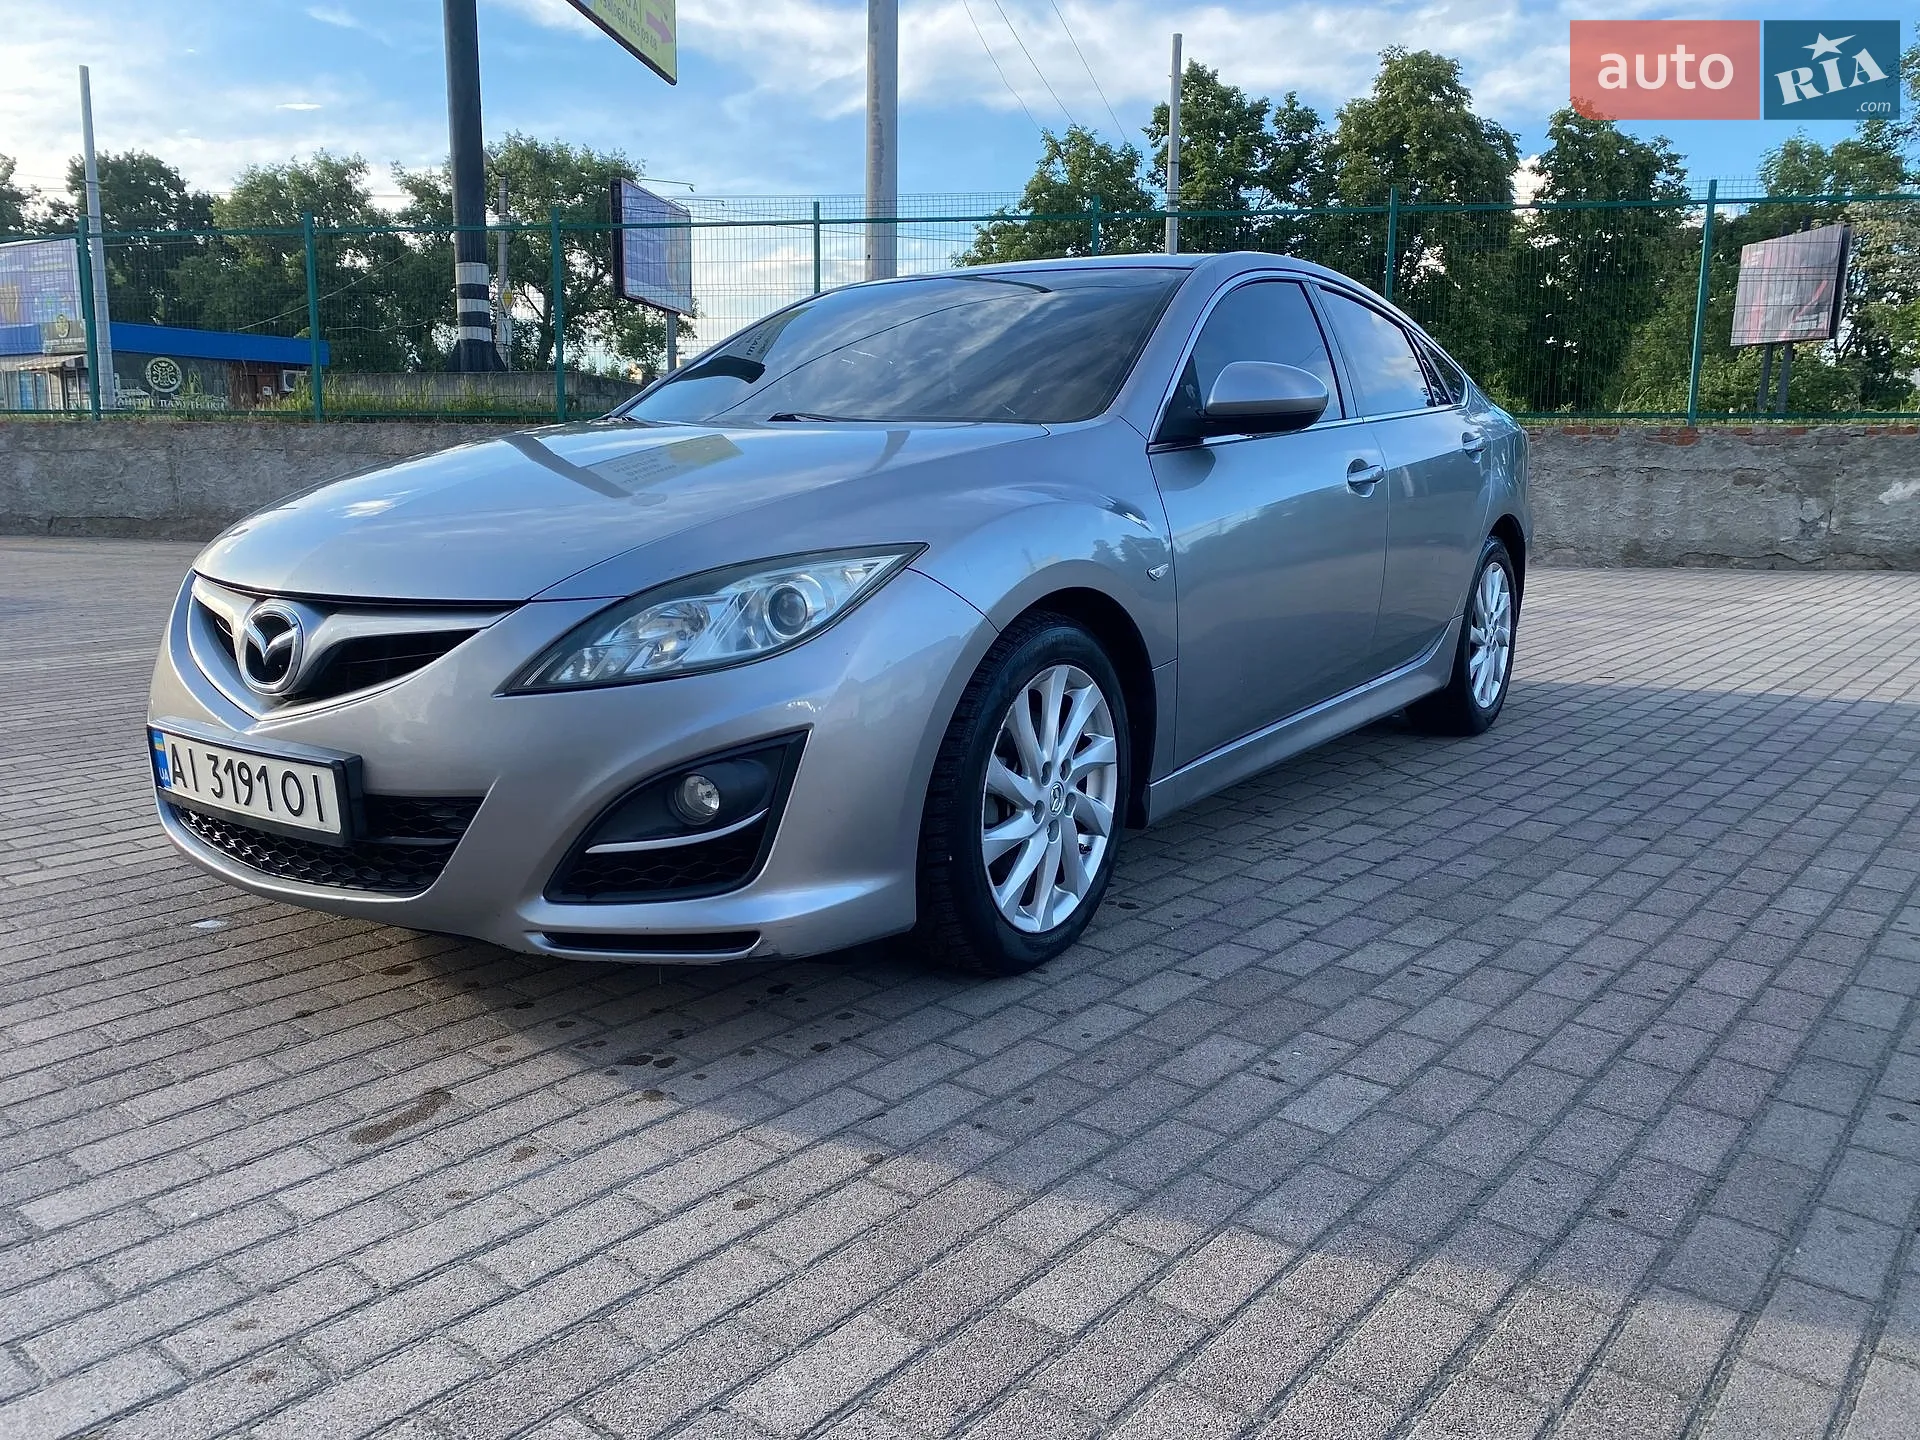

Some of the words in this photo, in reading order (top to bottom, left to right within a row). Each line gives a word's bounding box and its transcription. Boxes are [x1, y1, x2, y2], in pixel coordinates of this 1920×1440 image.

[159, 767, 170, 782] UA
[171, 743, 198, 792] AI
[206, 753, 273, 812] 3191
[281, 770, 324, 822] OI
